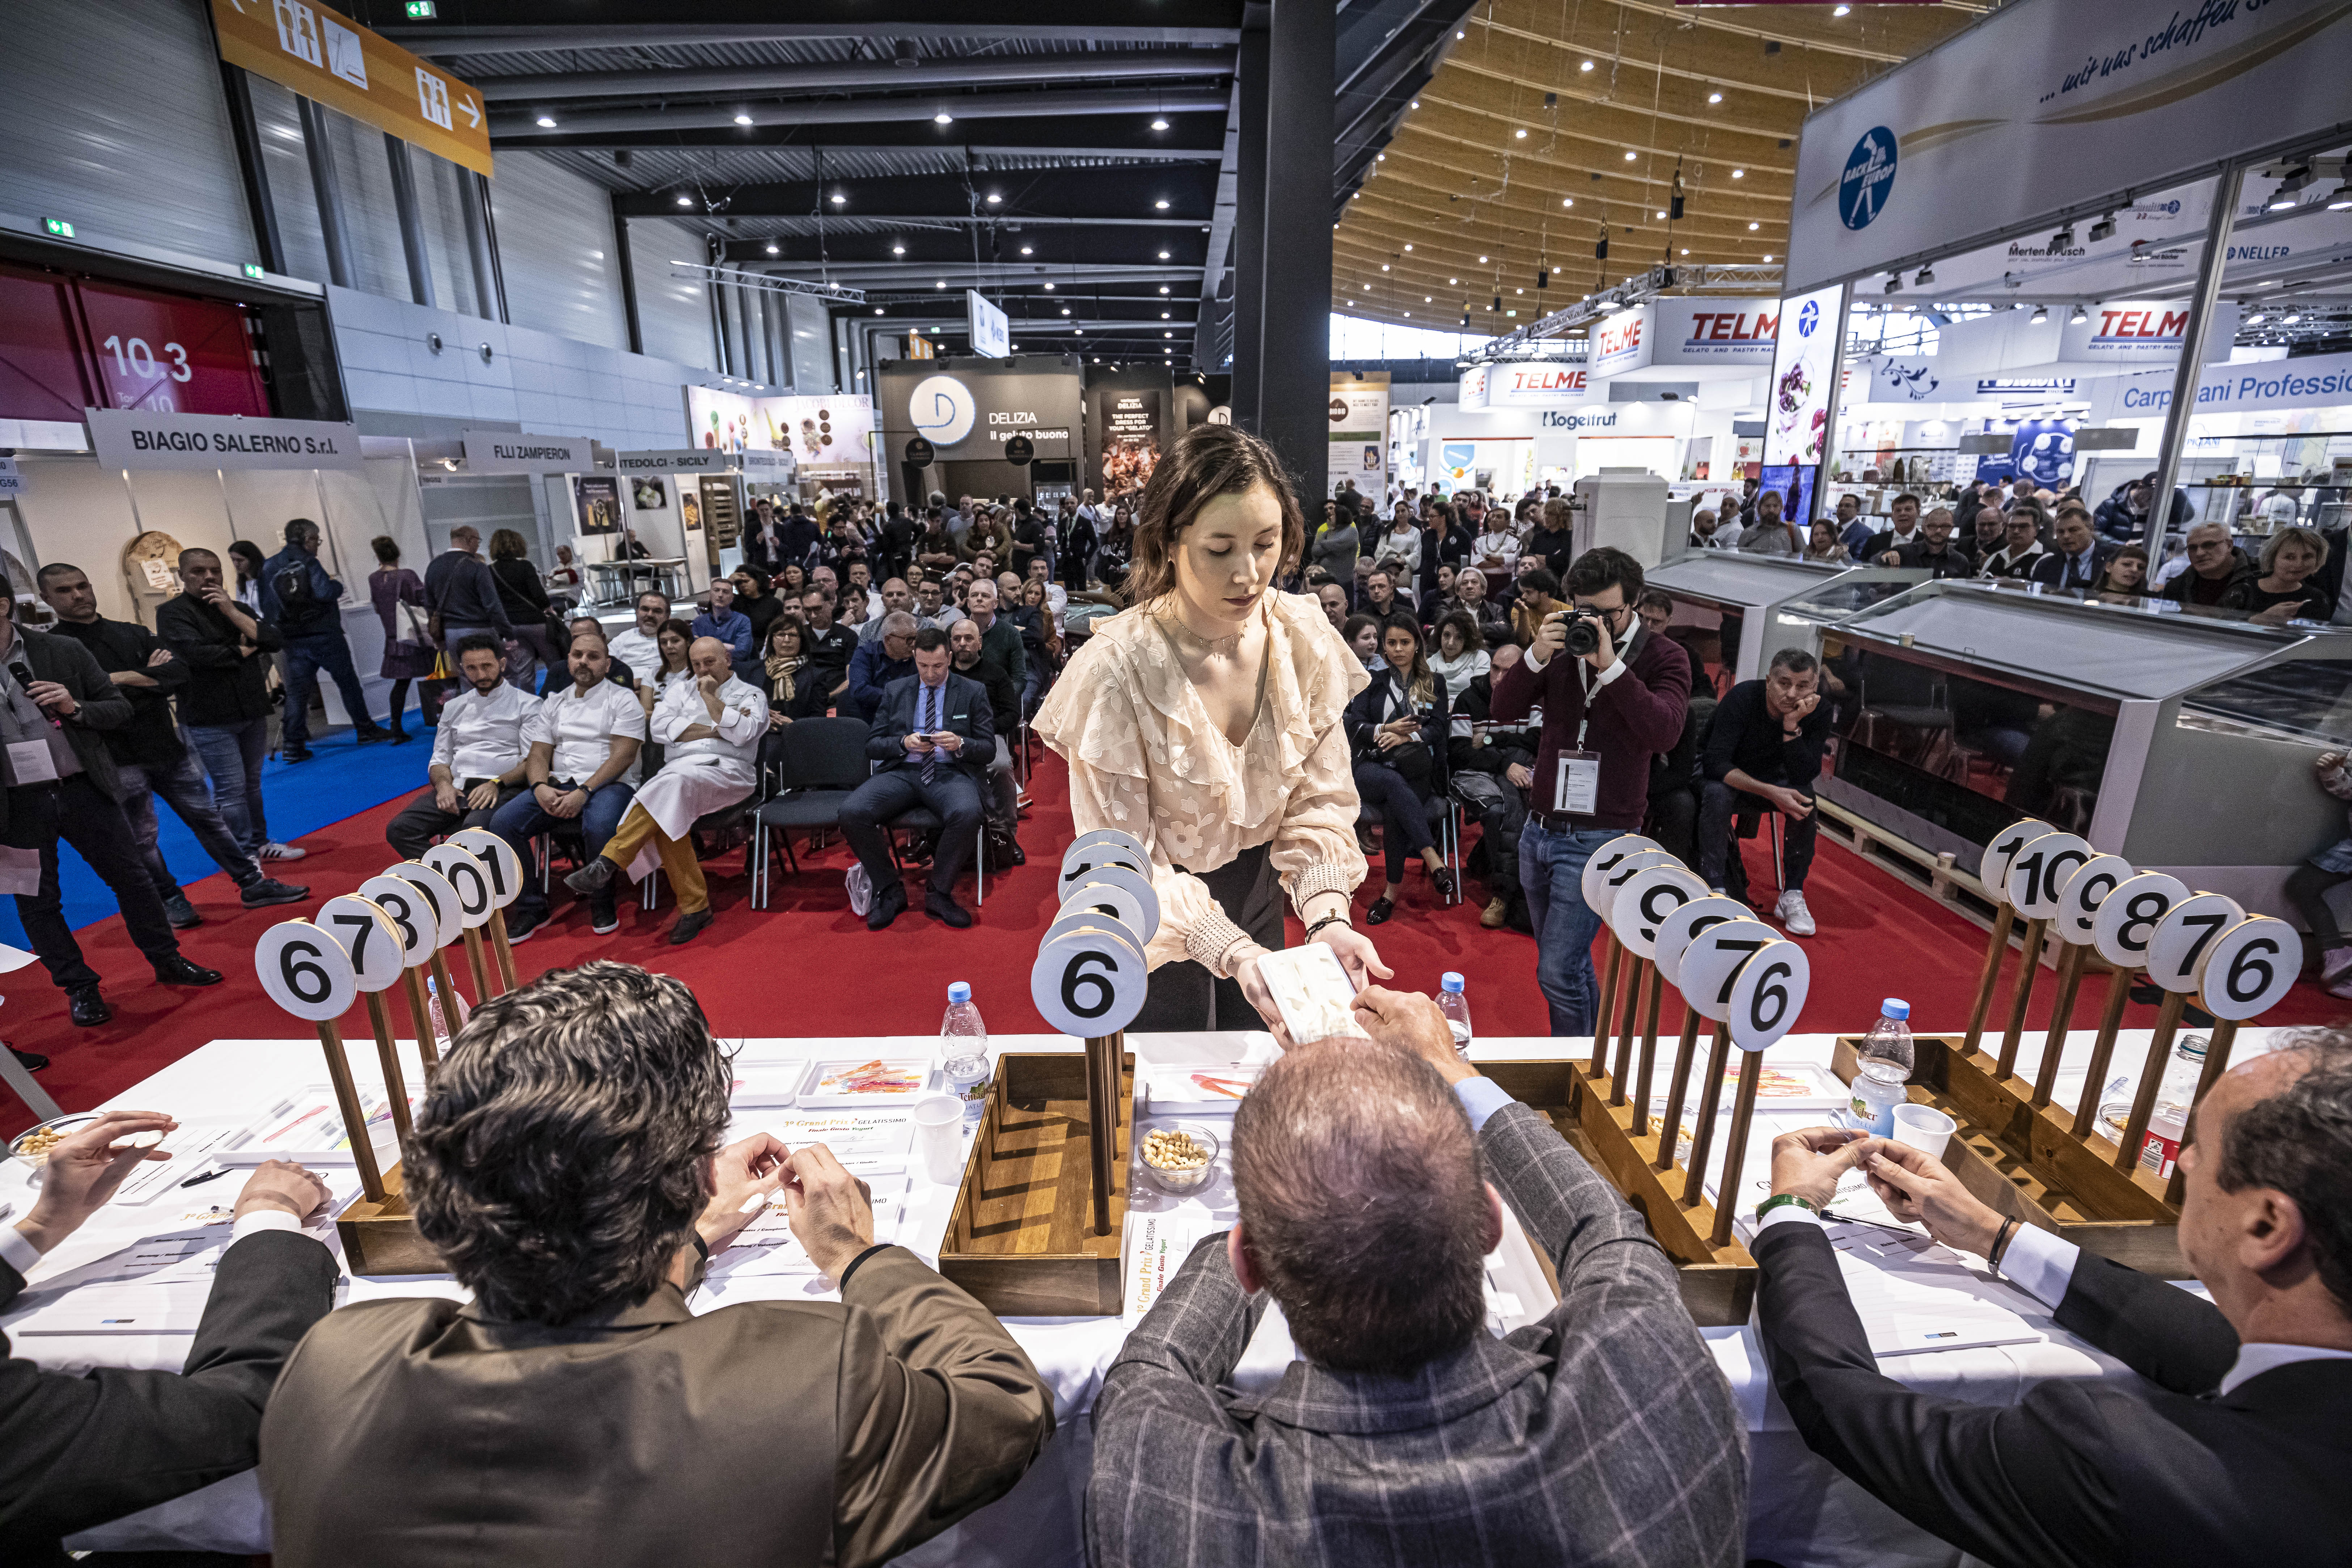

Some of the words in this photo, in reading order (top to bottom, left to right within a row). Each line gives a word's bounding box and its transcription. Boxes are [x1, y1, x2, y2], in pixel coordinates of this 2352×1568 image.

[2061, 56, 2099, 93] mit
[2101, 43, 2136, 76] uns
[2140, 0, 2239, 59] schaffen
[1843, 161, 1870, 184] BACK
[1862, 163, 1895, 187] EUROP
[2009, 246, 2045, 256] Merten
[2237, 246, 2289, 260] NELLER
[1600, 318, 1644, 356] TELME
[1692, 313, 1779, 340] TELM
[2100, 310, 2190, 337] TELM
[104, 335, 192, 383] 10.3
[1515, 371, 1587, 389] TELME
[2124, 379, 2233, 411] Carpani
[989, 412, 1038, 425] DELIZIA
[131, 430, 208, 451] BIAGIO
[212, 434, 301, 453] SALERNO
[304, 437, 338, 455] S.r.l.
[990, 430, 997, 440] il
[999, 431, 1033, 442] gelto
[1035, 430, 1069, 440] buono
[494, 445, 515, 458] FLLI
[516, 446, 571, 460] ZAMPIERON
[677, 456, 709, 466] SICILY
[2016, 850, 2089, 905] 10
[1640, 884, 1690, 943] 9
[2077, 872, 2117, 930] 9
[2117, 892, 2170, 951] 8
[332, 914, 374, 975] 7
[2177, 913, 2228, 976] 7
[280, 940, 332, 1004] 6
[1061, 951, 1119, 1018] 6
[1715, 939, 1762, 1004] 7
[2226, 938, 2280, 1002] 6
[1751, 962, 1792, 1032] 6
[1835, 1182, 1867, 1195] ATISSIMO
[1145, 1218, 1156, 1251] GELATISSIMO
[1159, 1239, 1168, 1254] Yogurt
[1140, 1257, 1152, 1274] Prix
[1137, 1277, 1151, 1303] Grand
